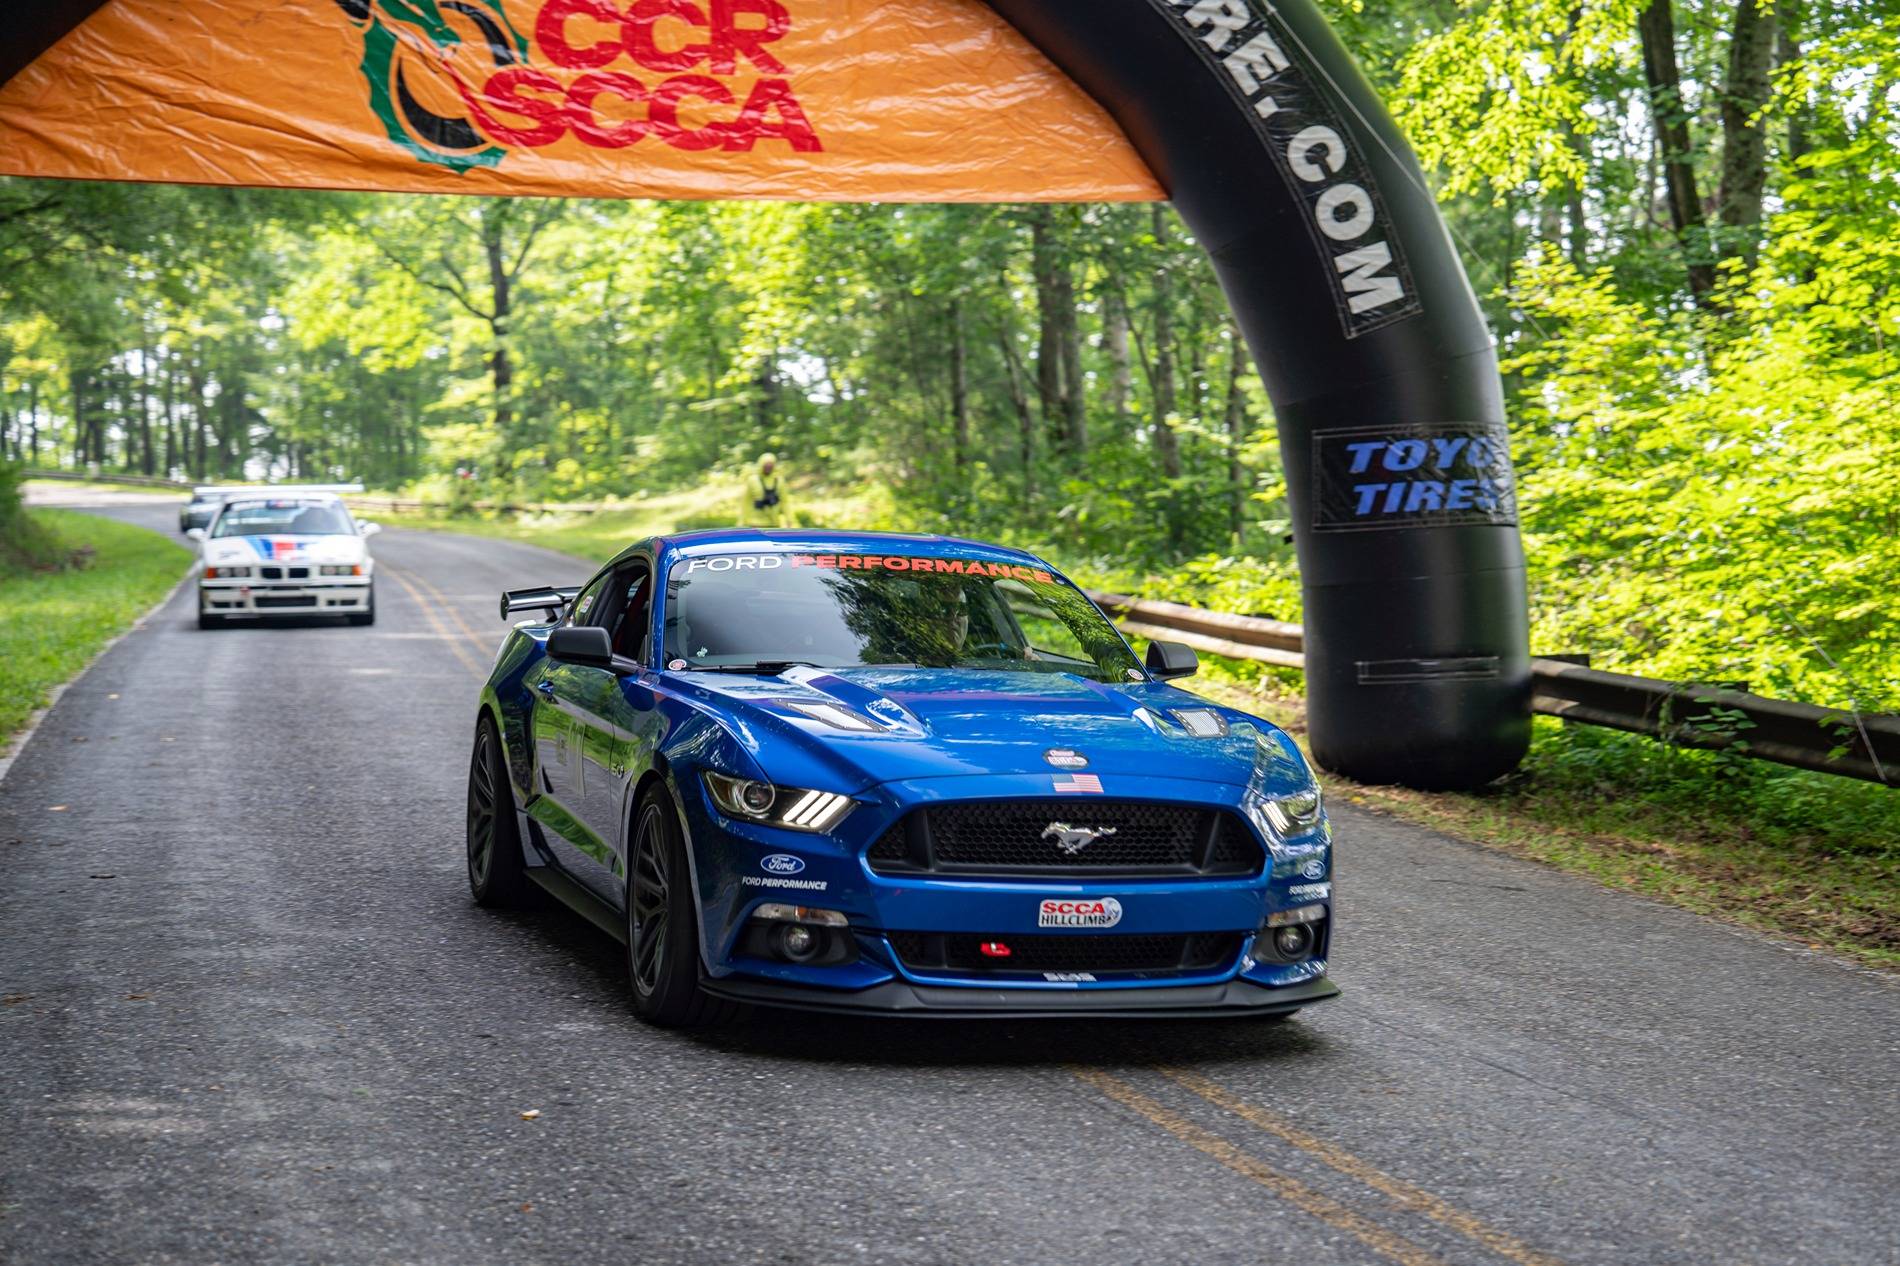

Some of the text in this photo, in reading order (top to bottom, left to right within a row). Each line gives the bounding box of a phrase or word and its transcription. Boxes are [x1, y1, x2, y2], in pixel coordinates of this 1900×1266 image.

[535, 0, 793, 75] CCR
[466, 69, 823, 152] SCCA
[1346, 437, 1494, 474] TOYO
[687, 555, 1054, 584] FORD PERFORMANCE
[742, 876, 827, 890] FORD PERFORMANCE
[1041, 914, 1106, 925] HILLCLIMB
[1042, 901, 1105, 914] SCCA
